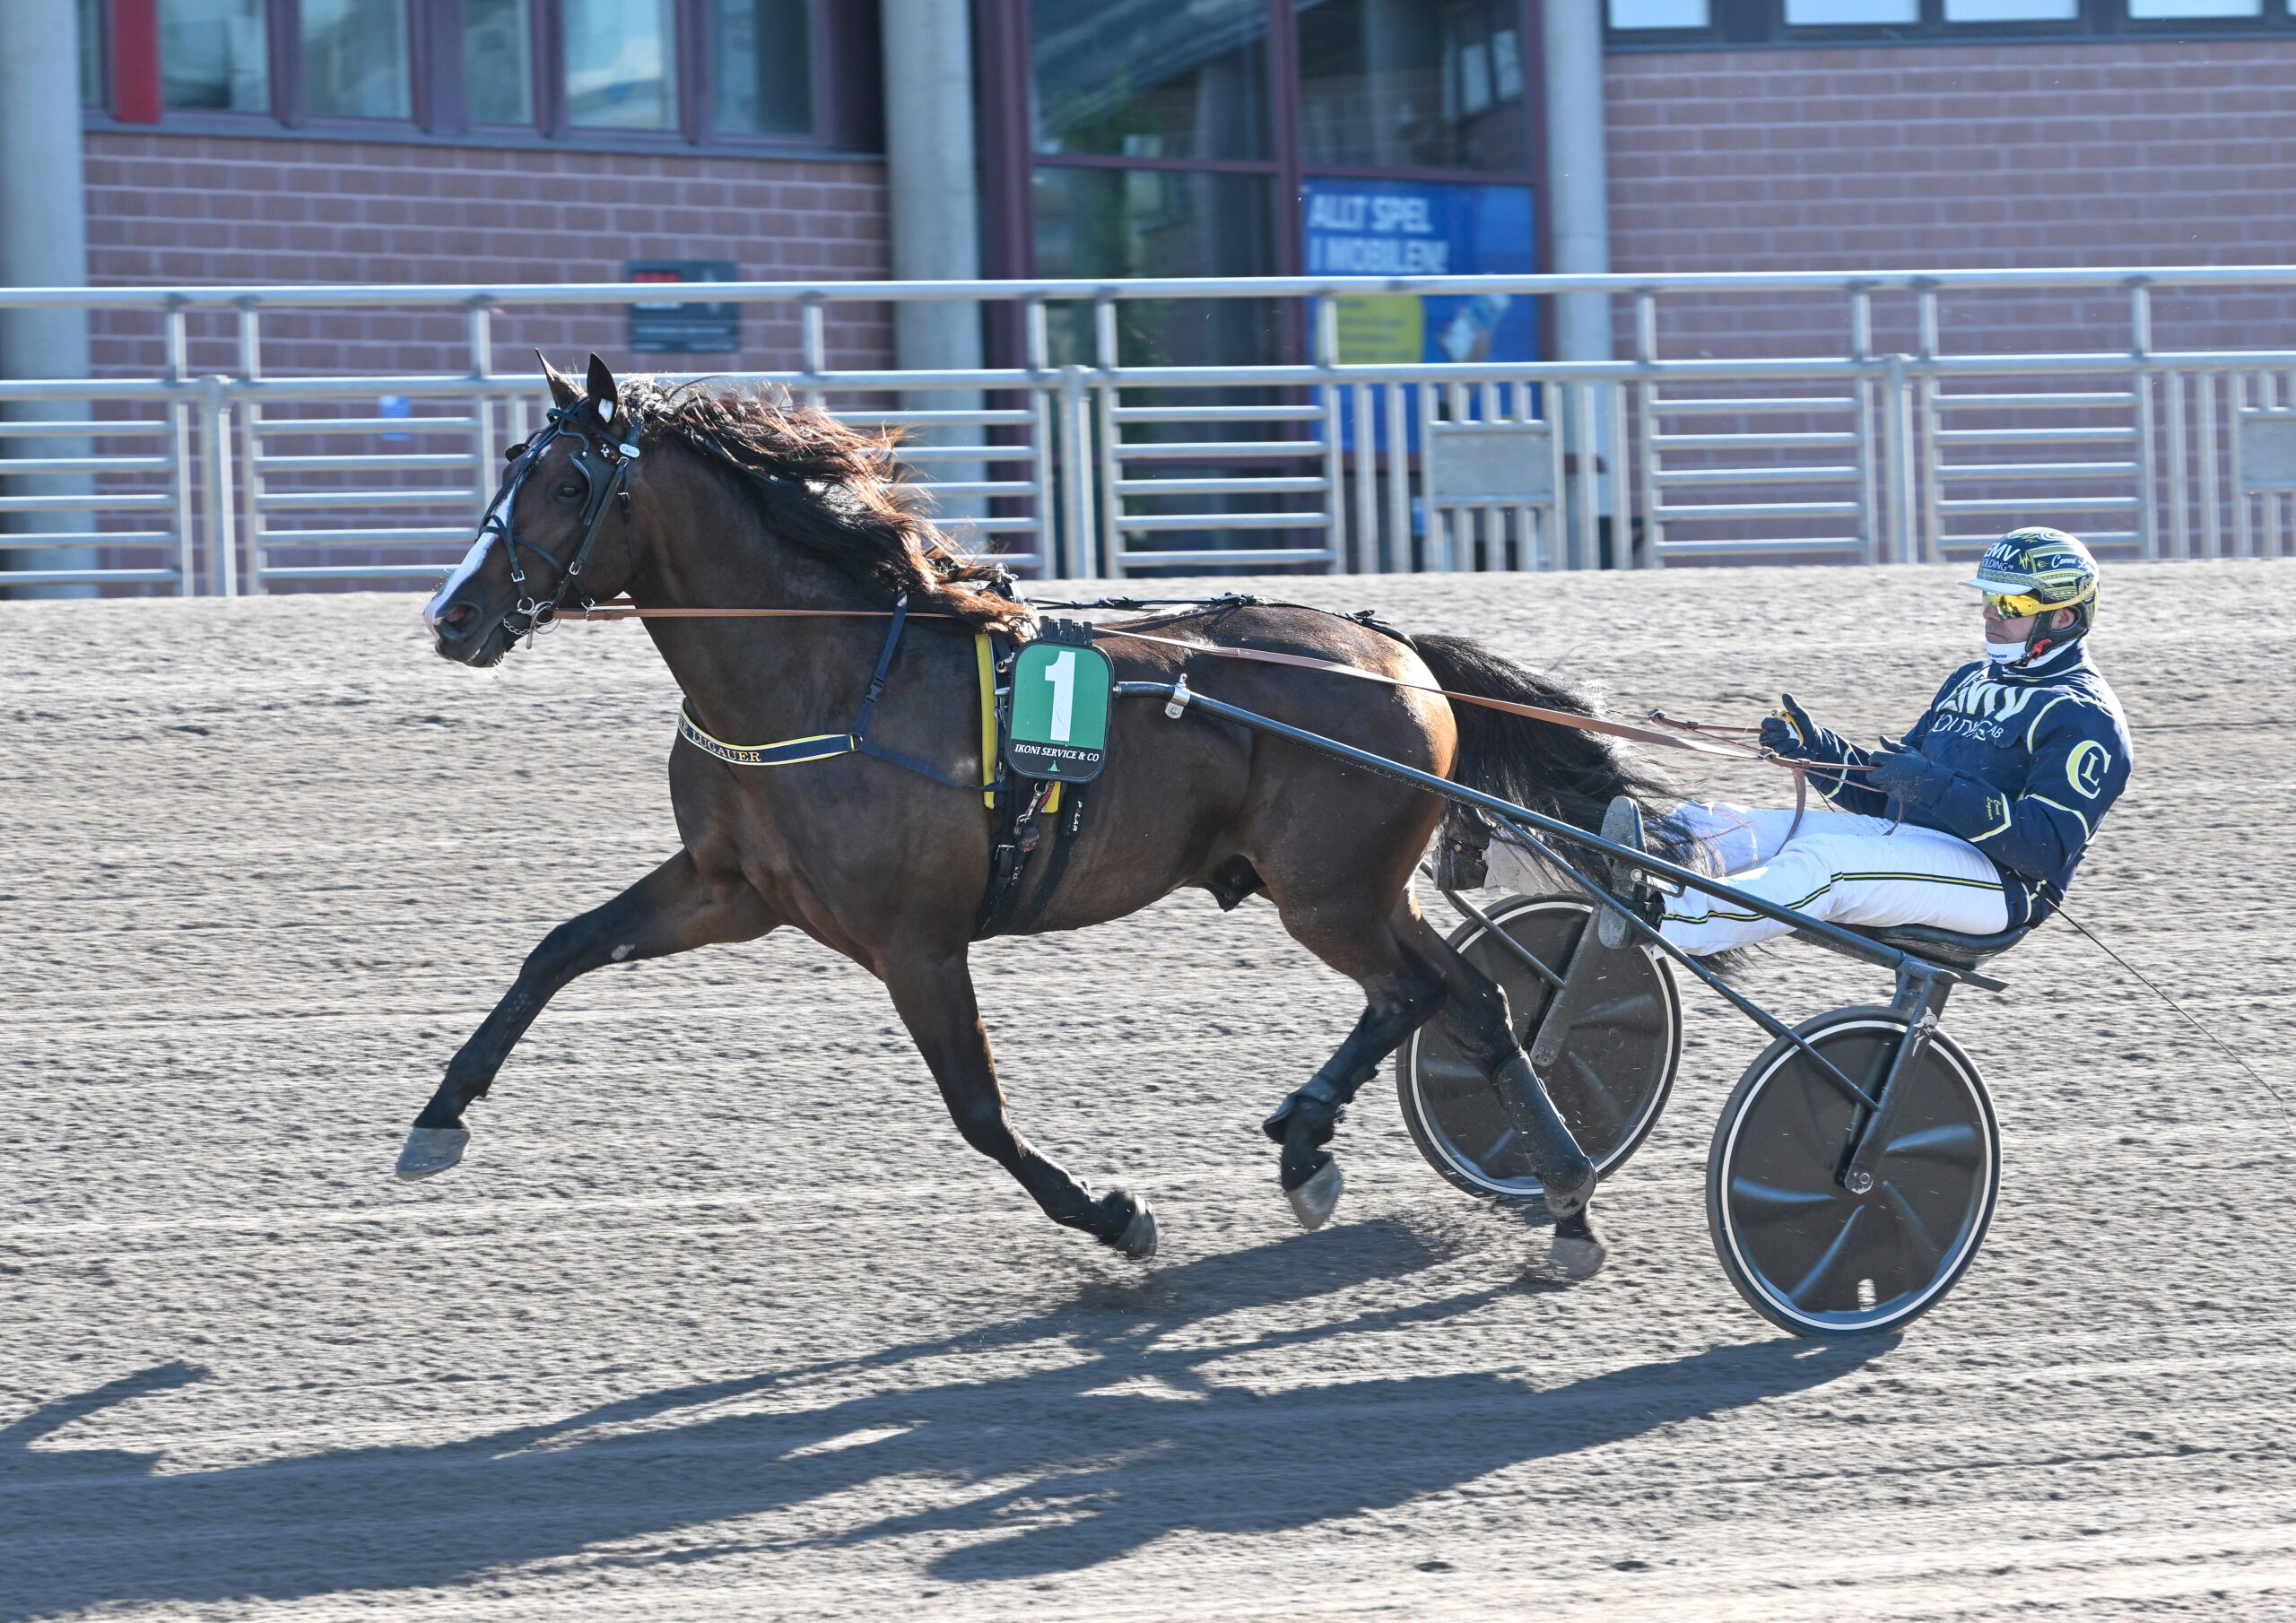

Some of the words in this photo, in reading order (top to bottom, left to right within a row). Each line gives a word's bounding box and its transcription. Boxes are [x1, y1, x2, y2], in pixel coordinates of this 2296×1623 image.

[1308, 194, 1367, 230] ALLT
[1370, 195, 1432, 234] SPEL
[1982, 559, 2008, 571] OLDING
[1045, 650, 1075, 742] 1
[691, 729, 761, 762] LUGAUER
[1014, 743, 1041, 755] IKONI
[1040, 747, 1078, 759] SERVICE
[1077, 751, 1085, 761] &
[1086, 753, 1100, 762] CO
